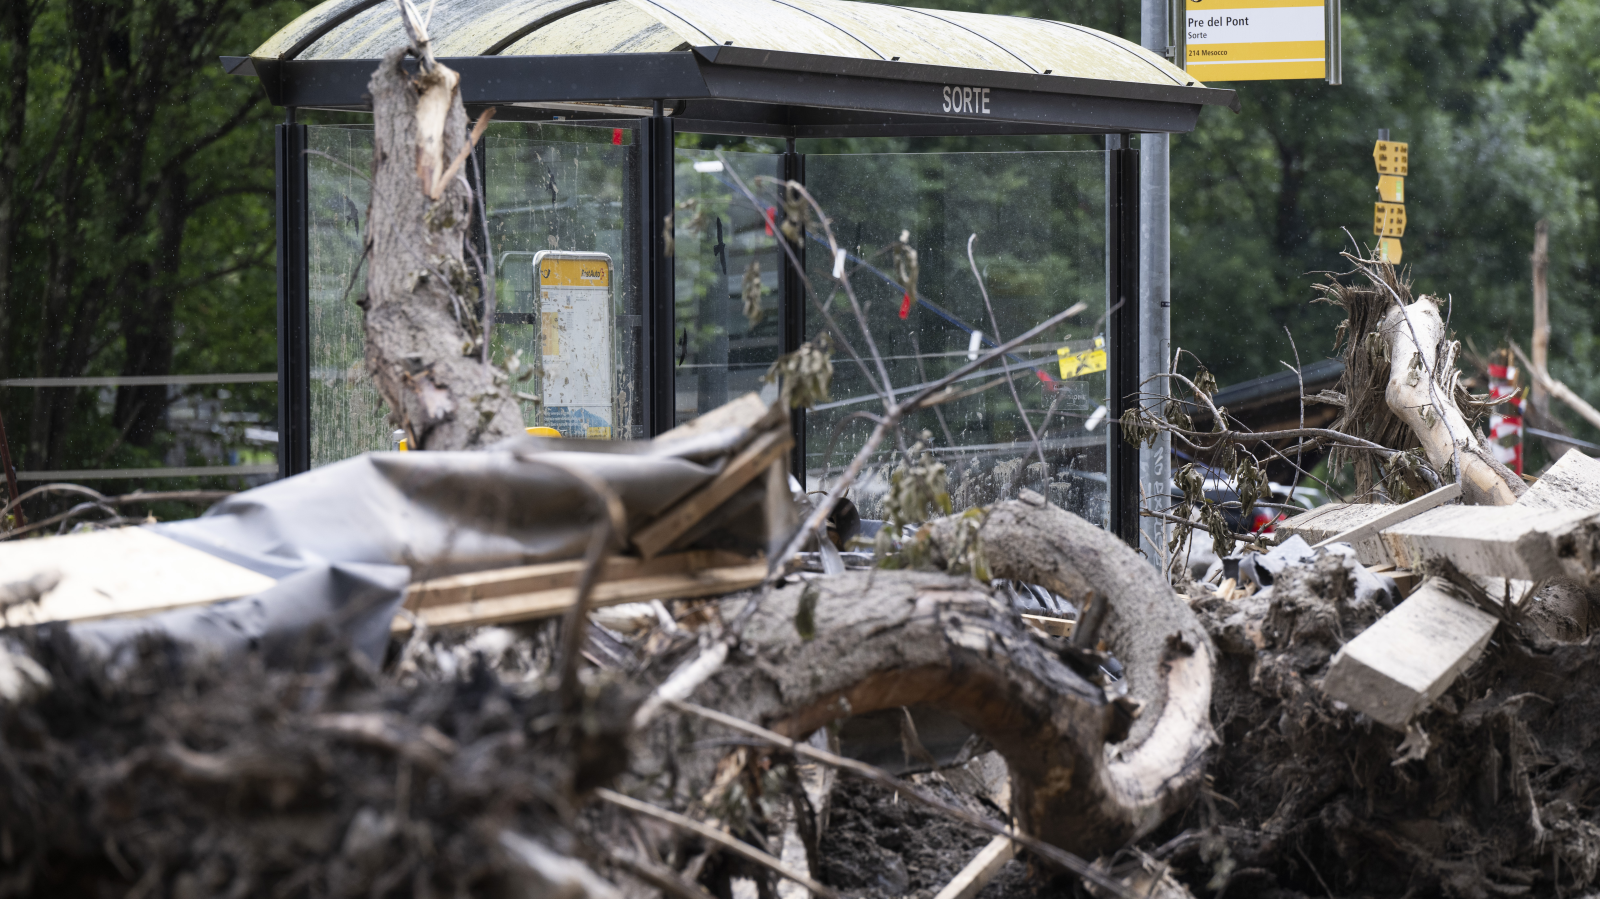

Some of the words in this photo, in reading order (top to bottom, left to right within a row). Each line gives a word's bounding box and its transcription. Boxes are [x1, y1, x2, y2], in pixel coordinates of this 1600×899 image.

[1188, 17, 1204, 27] Pre
[1207, 16, 1223, 27] del
[1226, 16, 1249, 26] Pont
[942, 85, 991, 114] SORTE
[1153, 481, 1164, 567] EXUSE
